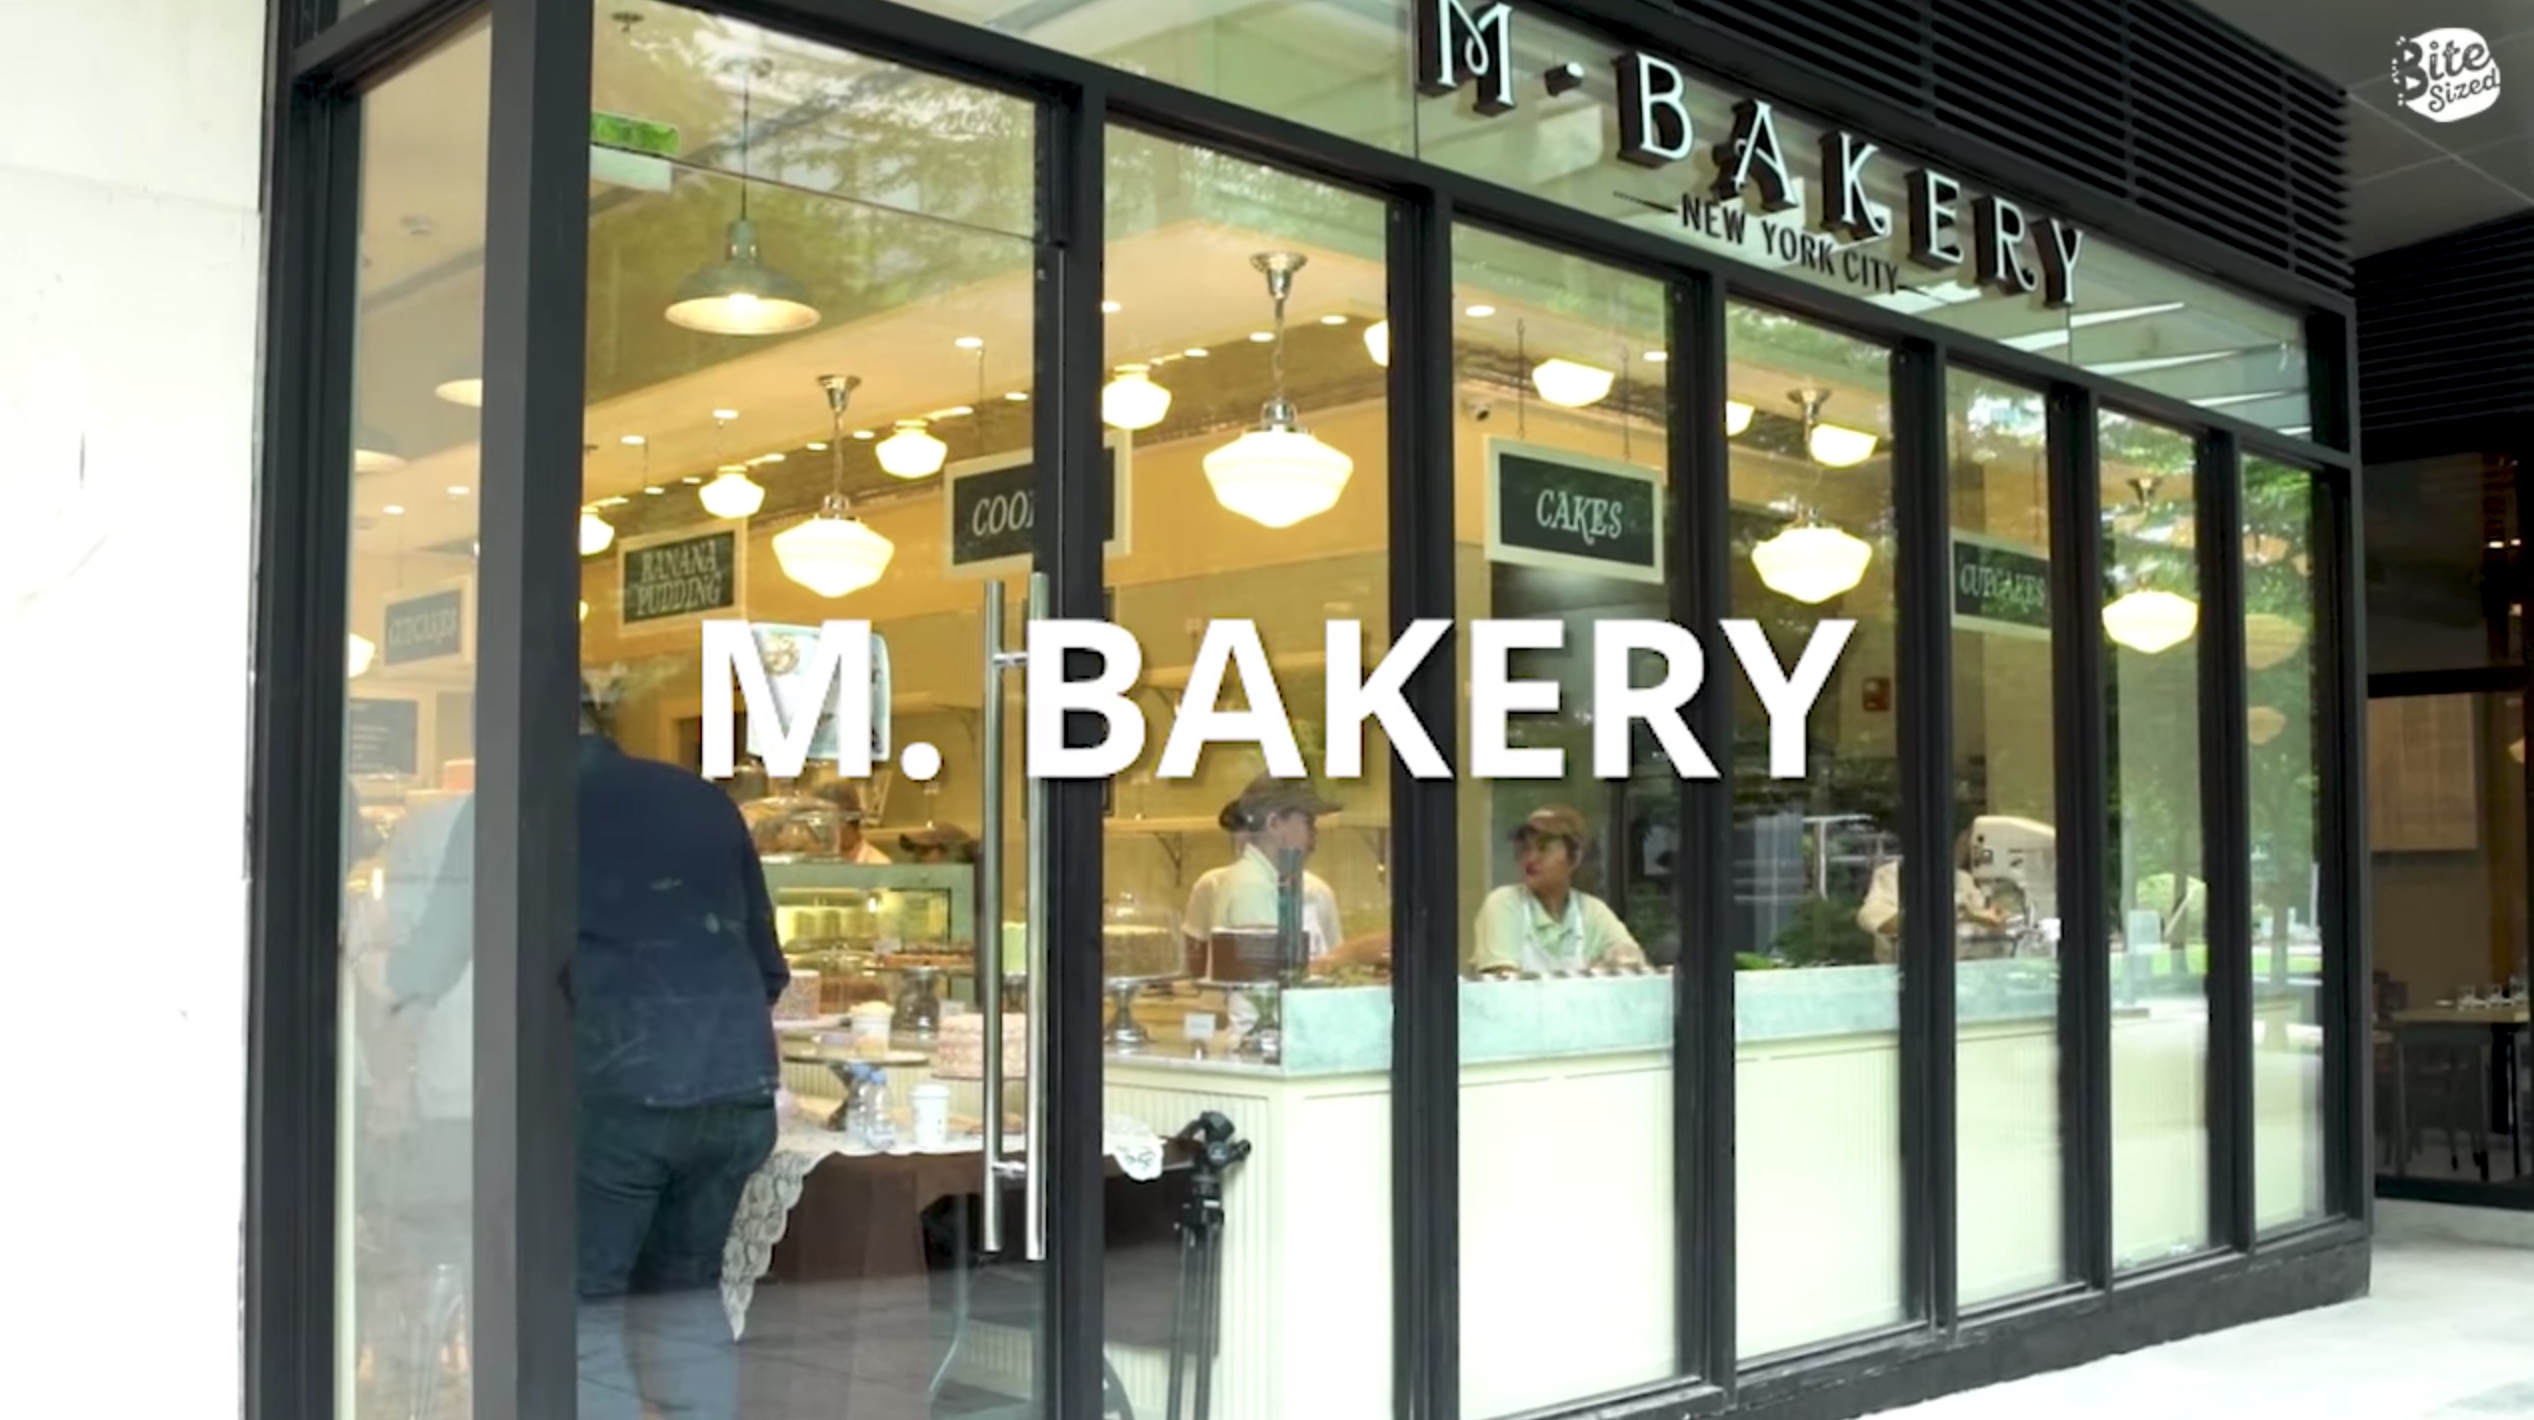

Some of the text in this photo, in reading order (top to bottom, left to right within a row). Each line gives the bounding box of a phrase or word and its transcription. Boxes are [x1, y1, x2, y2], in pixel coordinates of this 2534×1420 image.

[1618, 52, 2082, 306] BAKERY
[1681, 193, 1900, 295] NEW YORK CITY
[1536, 489, 1623, 546] CAKES
[641, 539, 717, 583] BANANA
[637, 571, 722, 616] PUDDING
